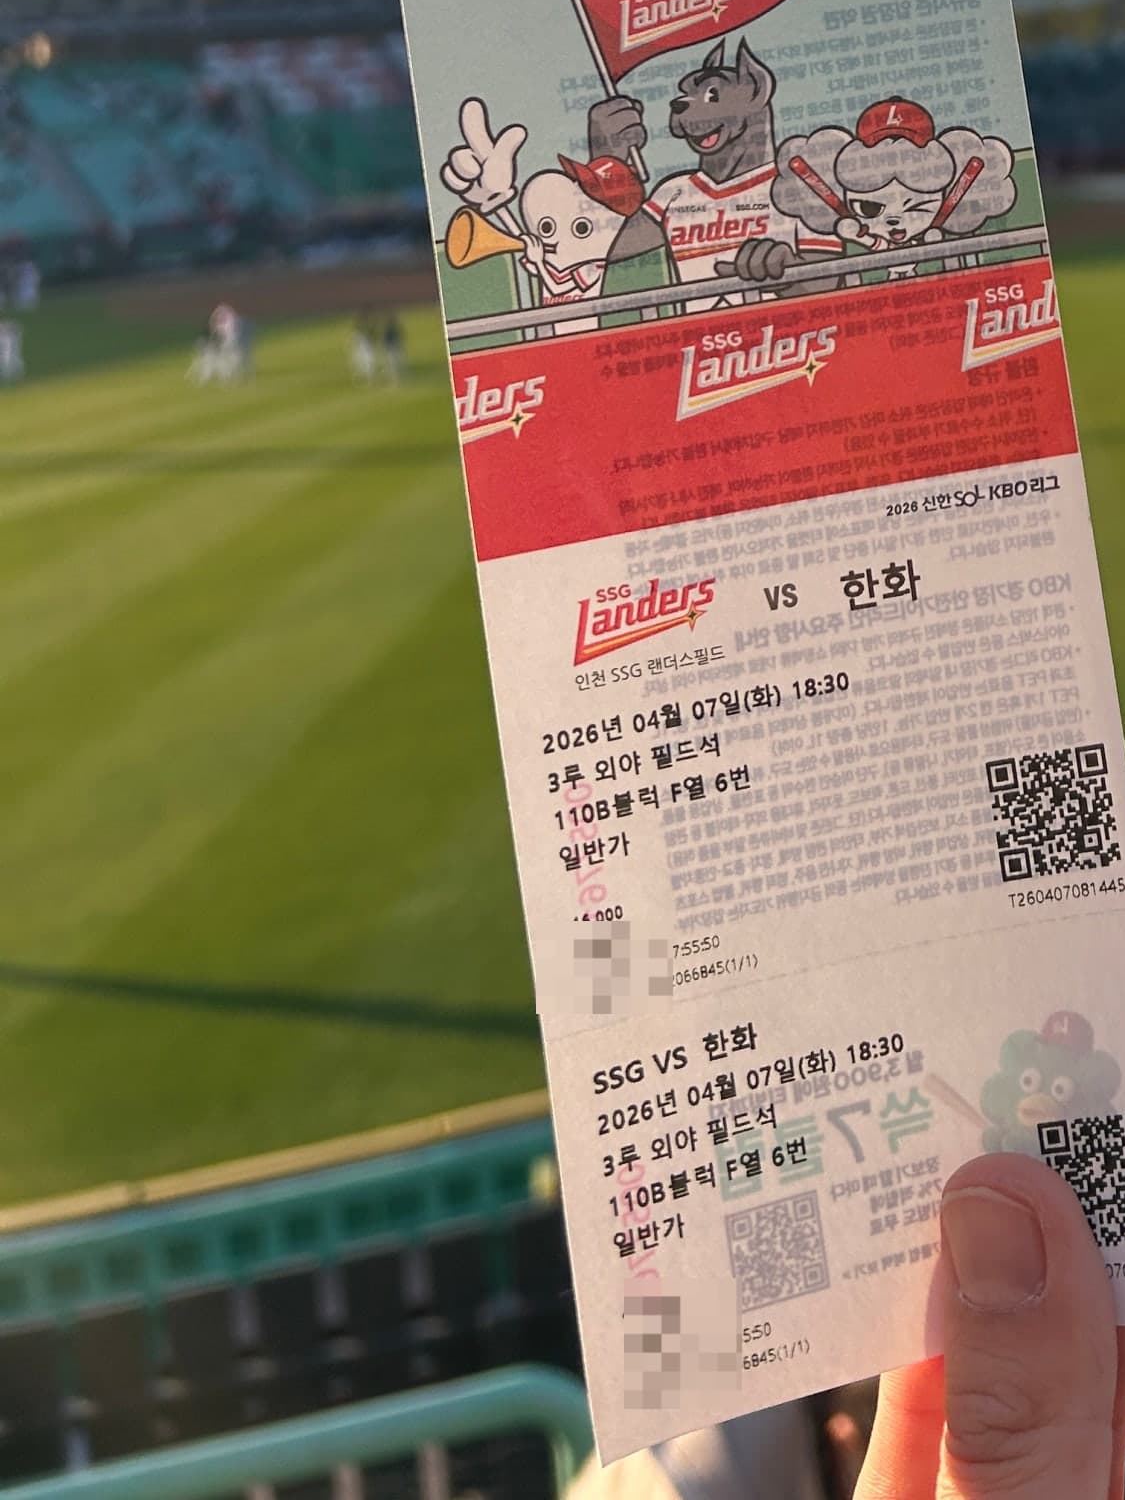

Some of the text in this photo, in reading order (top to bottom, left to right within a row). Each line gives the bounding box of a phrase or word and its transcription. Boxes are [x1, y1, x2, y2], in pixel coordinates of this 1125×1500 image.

[664, 209, 770, 247] anders
[985, 283, 1024, 303] SSG
[702, 331, 743, 351] SSG
[961, 279, 1062, 373] Land
[676, 324, 838, 422] Landers
[886, 500, 918, 517] 2026
[922, 493, 952, 512] 신한
[954, 484, 985, 507] SOL
[573, 558, 921, 667] Landers VS 한화
[596, 584, 632, 603] SSG
[575, 669, 607, 692] 인천
[611, 662, 643, 683] SSG
[647, 645, 726, 676] 랜더스필드
[542, 671, 850, 754] 2026년 04월 07일(화) 18:30
[548, 732, 722, 794] 3루 외야 필드석
[554, 783, 660, 831] 110B블럭
[671, 773, 706, 804] F열
[715, 764, 752, 793] 6번
[558, 831, 631, 872] 일반가
[672, 953, 758, 986] 066845(1/1)
[592, 1021, 758, 1095] SSG VS 한화
[597, 1032, 904, 1136] 2026년 04월 07일(화) 18:30
[603, 1102, 778, 1177] 3루 외야 필드석
[609, 1136, 808, 1217] 110B블럭 F열 6번
[612, 1212, 684, 1259] 일반가
